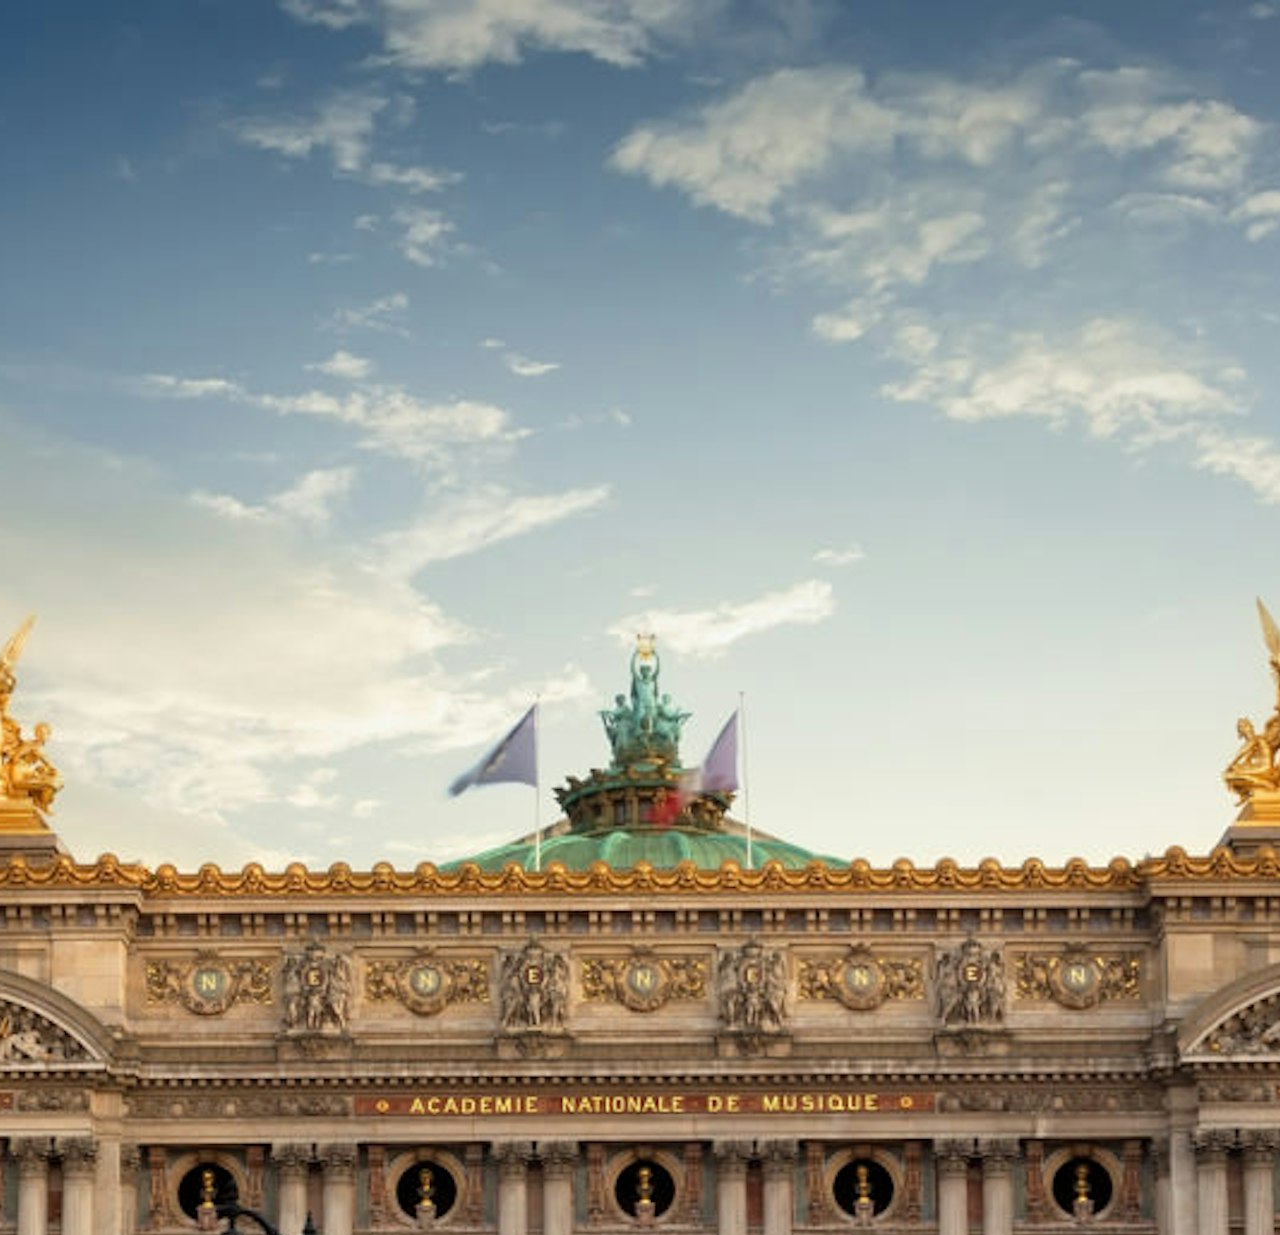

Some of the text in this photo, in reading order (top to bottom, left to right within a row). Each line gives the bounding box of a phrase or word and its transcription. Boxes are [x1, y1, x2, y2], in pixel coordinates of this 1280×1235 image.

[202, 973, 216, 991] N
[308, 969, 320, 986] E
[419, 971, 432, 988] N
[528, 969, 539, 984] E
[637, 970, 650, 988] N
[854, 969, 868, 986] N
[966, 966, 978, 981] E
[1071, 967, 1085, 984] N
[409, 1094, 879, 1114] ACADEMIE NATIONALE DE MUSIQUE
